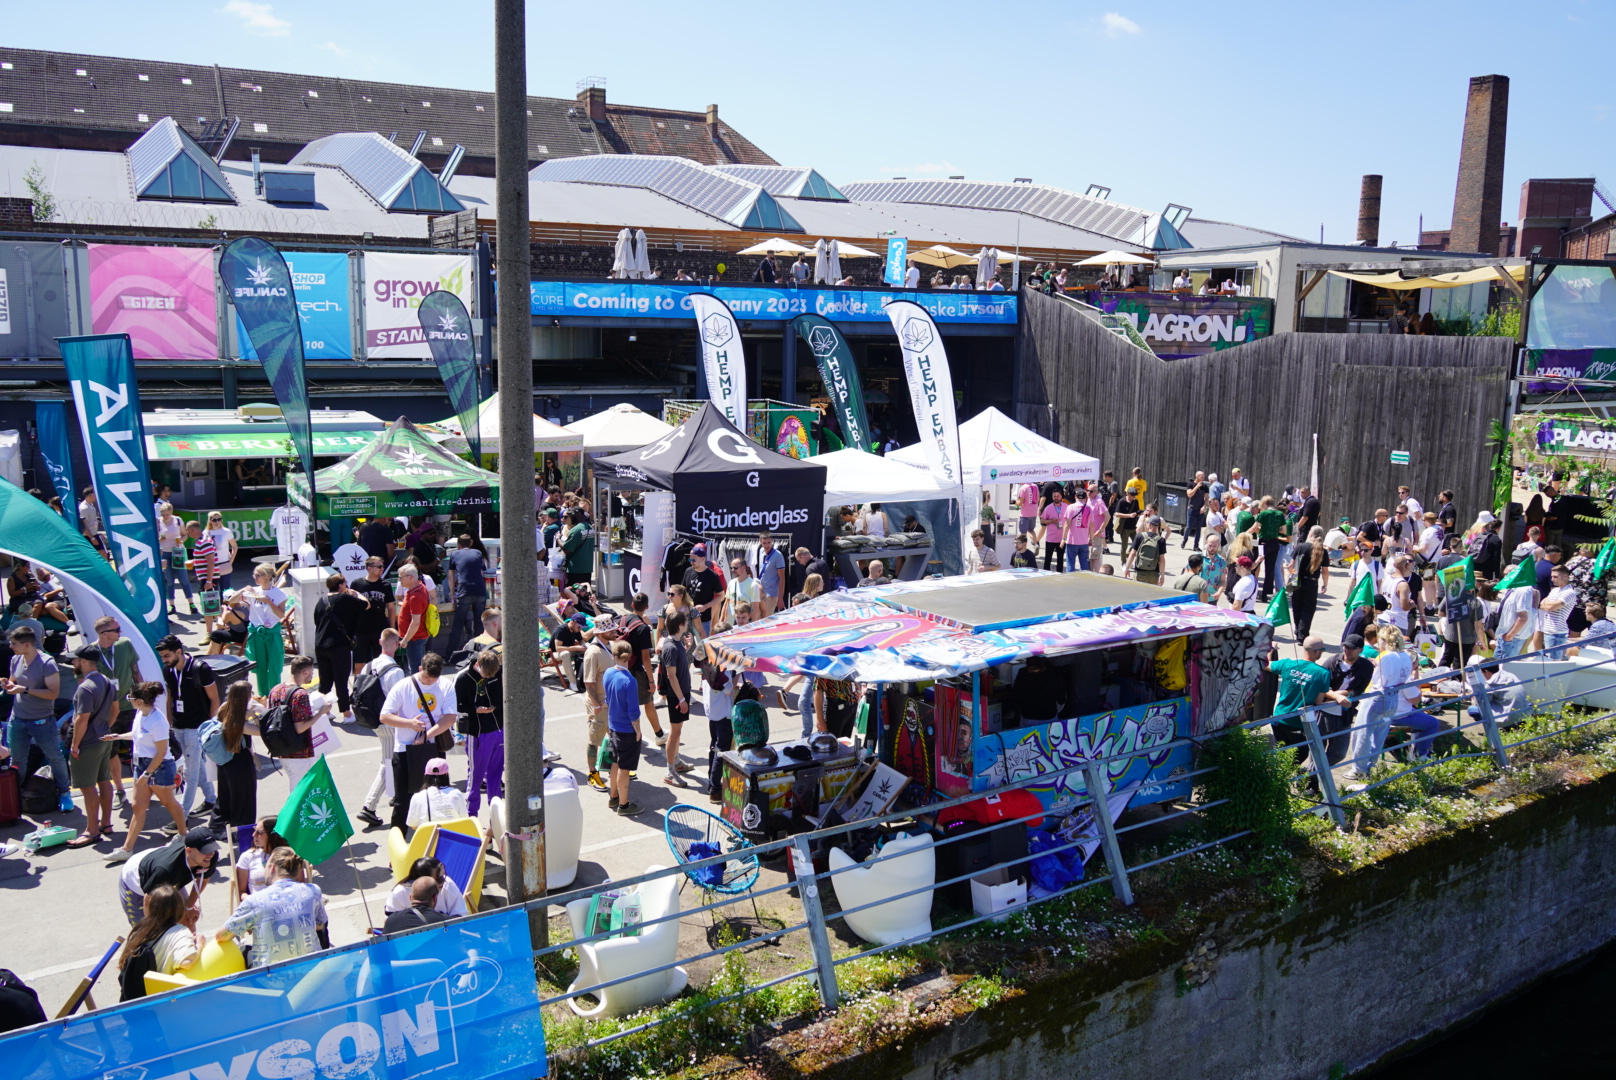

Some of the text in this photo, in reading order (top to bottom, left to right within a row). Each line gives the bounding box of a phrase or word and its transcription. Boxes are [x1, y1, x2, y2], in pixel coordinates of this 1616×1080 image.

[892, 241, 904, 280] Cookies
[374, 279, 440, 302] grow
[393, 293, 407, 308] in
[130, 297, 175, 309] GIZEH
[573, 292, 807, 314] Coming to Gany 2023
[816, 295, 868, 316] Cookies
[305, 341, 324, 349] 100
[716, 350, 732, 400] HEMP
[826, 356, 848, 403] HEMP
[917, 355, 937, 407] HEMP
[1551, 428, 1616, 450] PLAGR
[381, 466, 455, 477] CANLIFE
[746, 471, 760, 487] G
[384, 496, 500, 508] www.canlife-drinks.
[451, 970, 478, 995] 2.0
